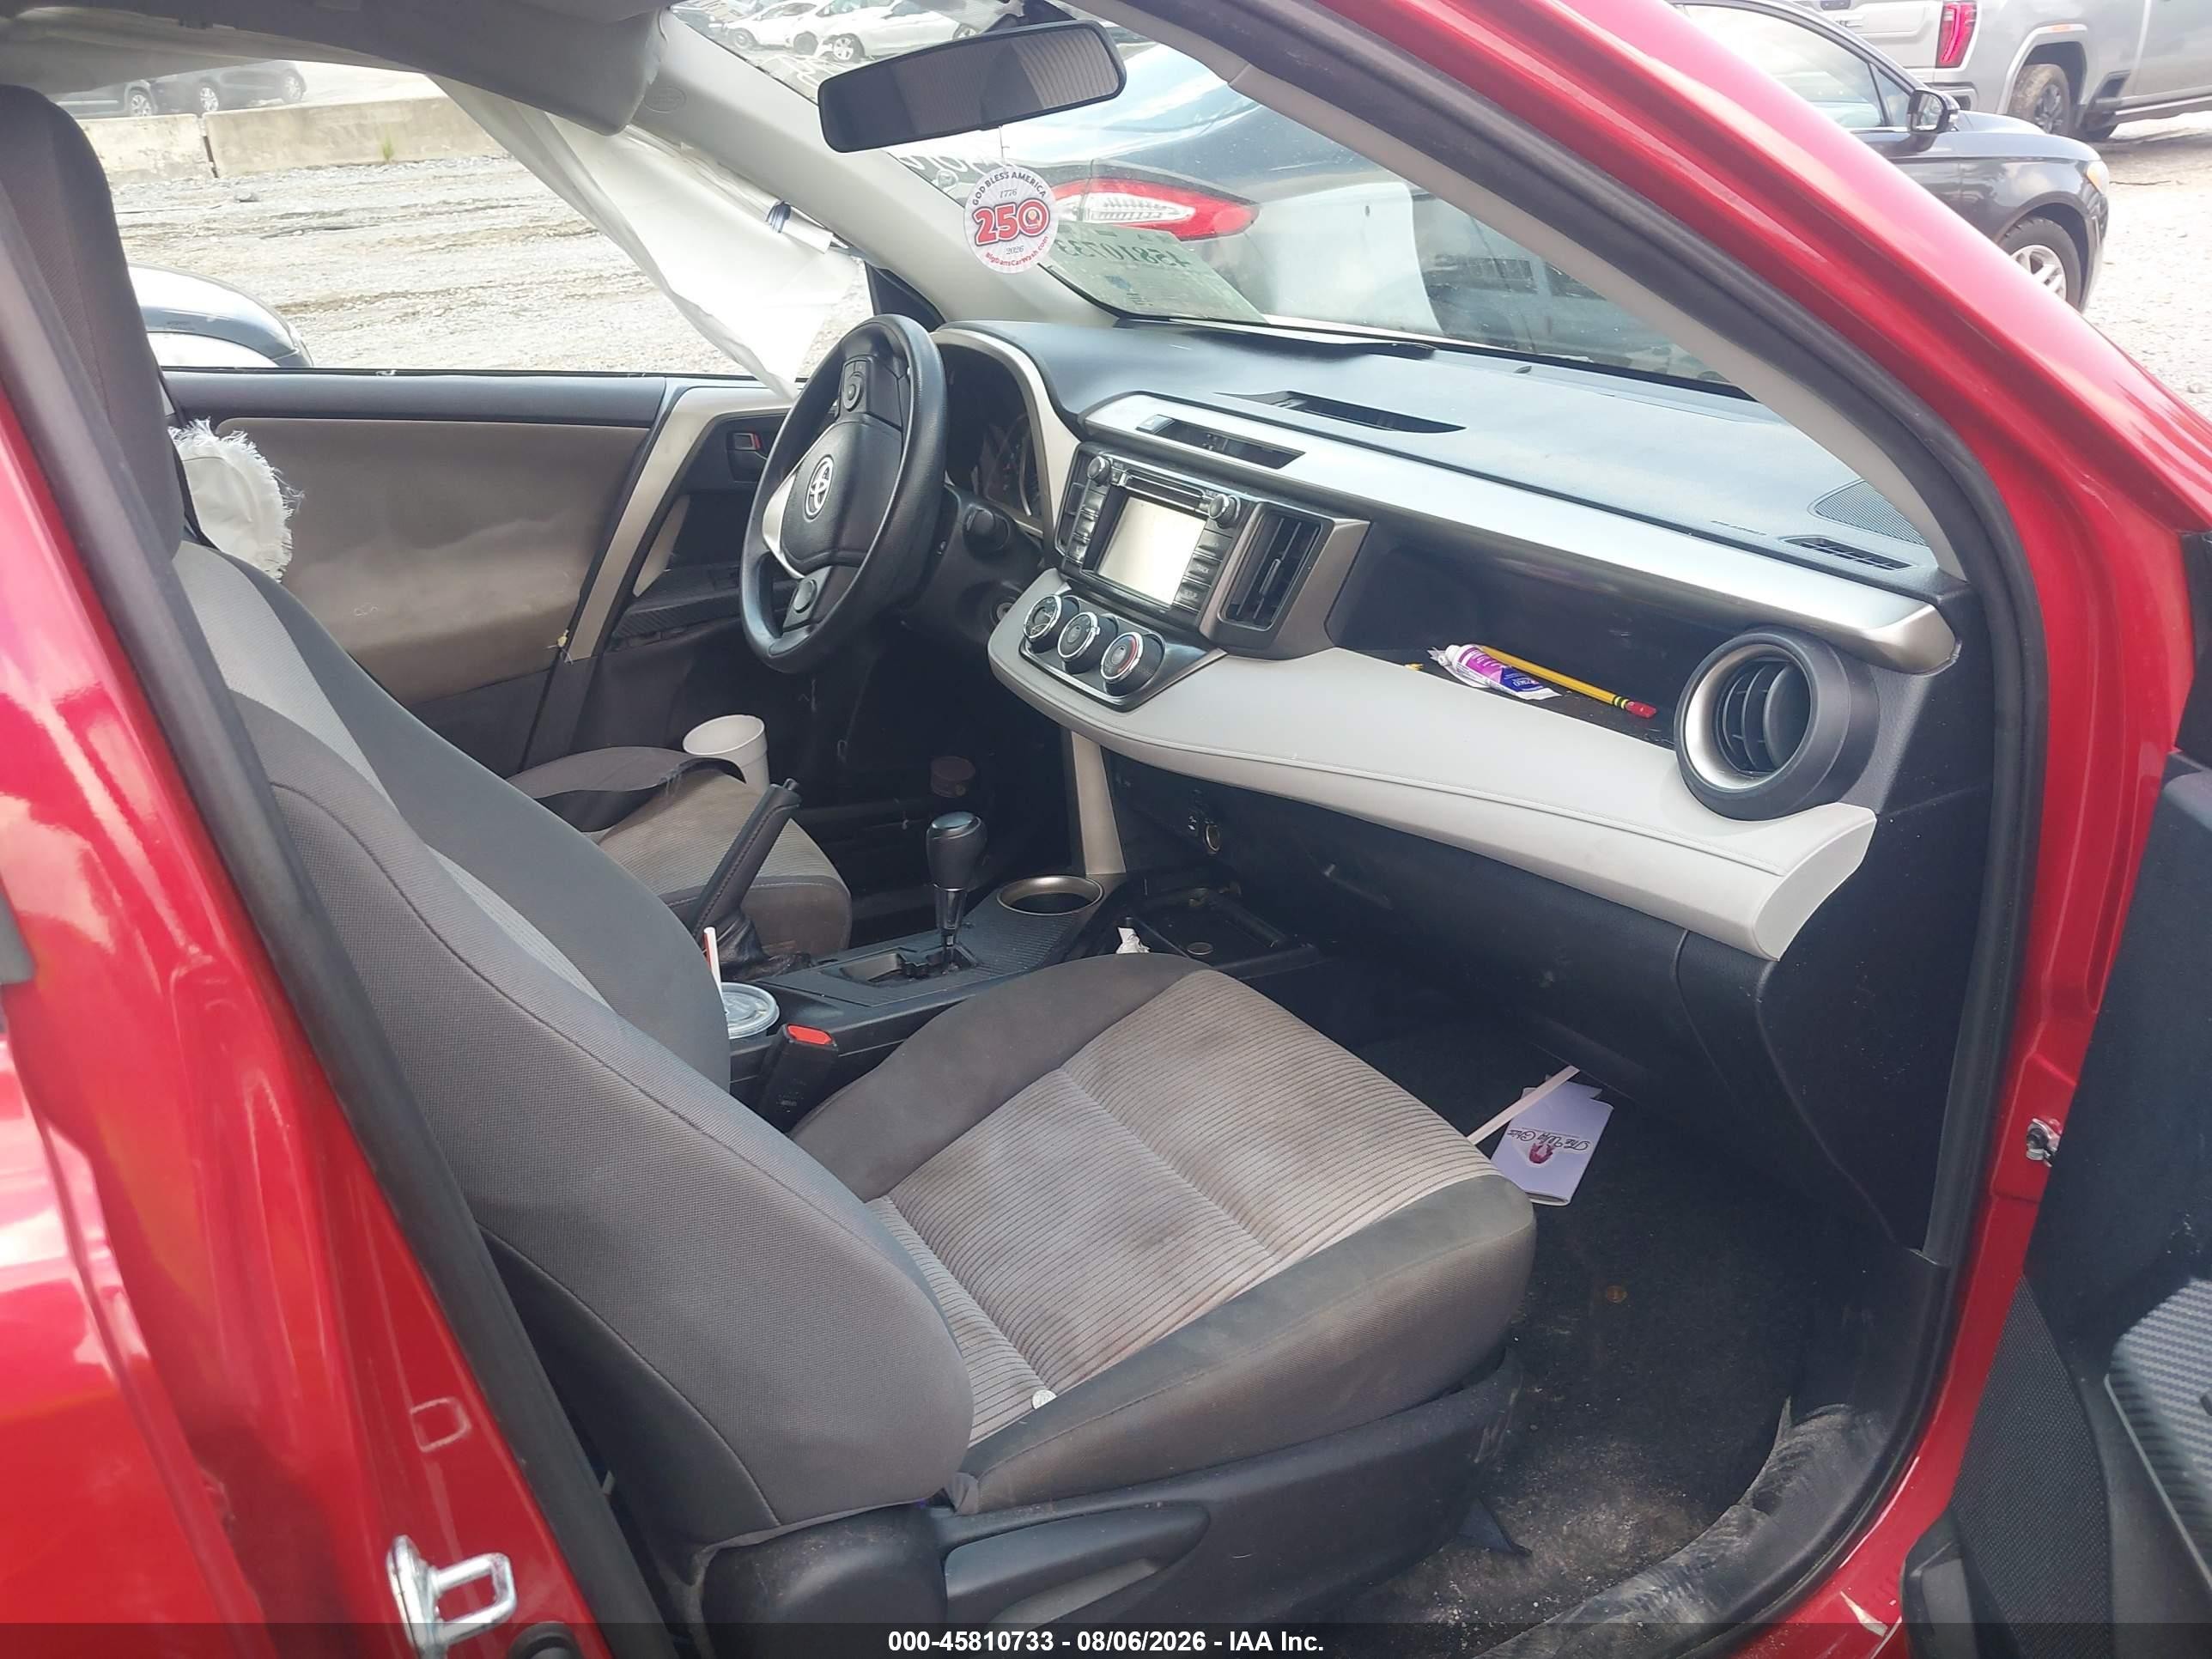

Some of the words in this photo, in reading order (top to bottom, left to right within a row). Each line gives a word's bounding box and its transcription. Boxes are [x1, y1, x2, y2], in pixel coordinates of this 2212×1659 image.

[972, 186, 986, 206] GOD
[985, 171, 1010, 188] BLESS
[1011, 171, 1048, 198] AMERICA
[999, 188, 1018, 199] 1776
[972, 198, 1050, 246] 250
[1005, 245, 1024, 256] 2026
[1565, 1139, 1590, 1151] The
